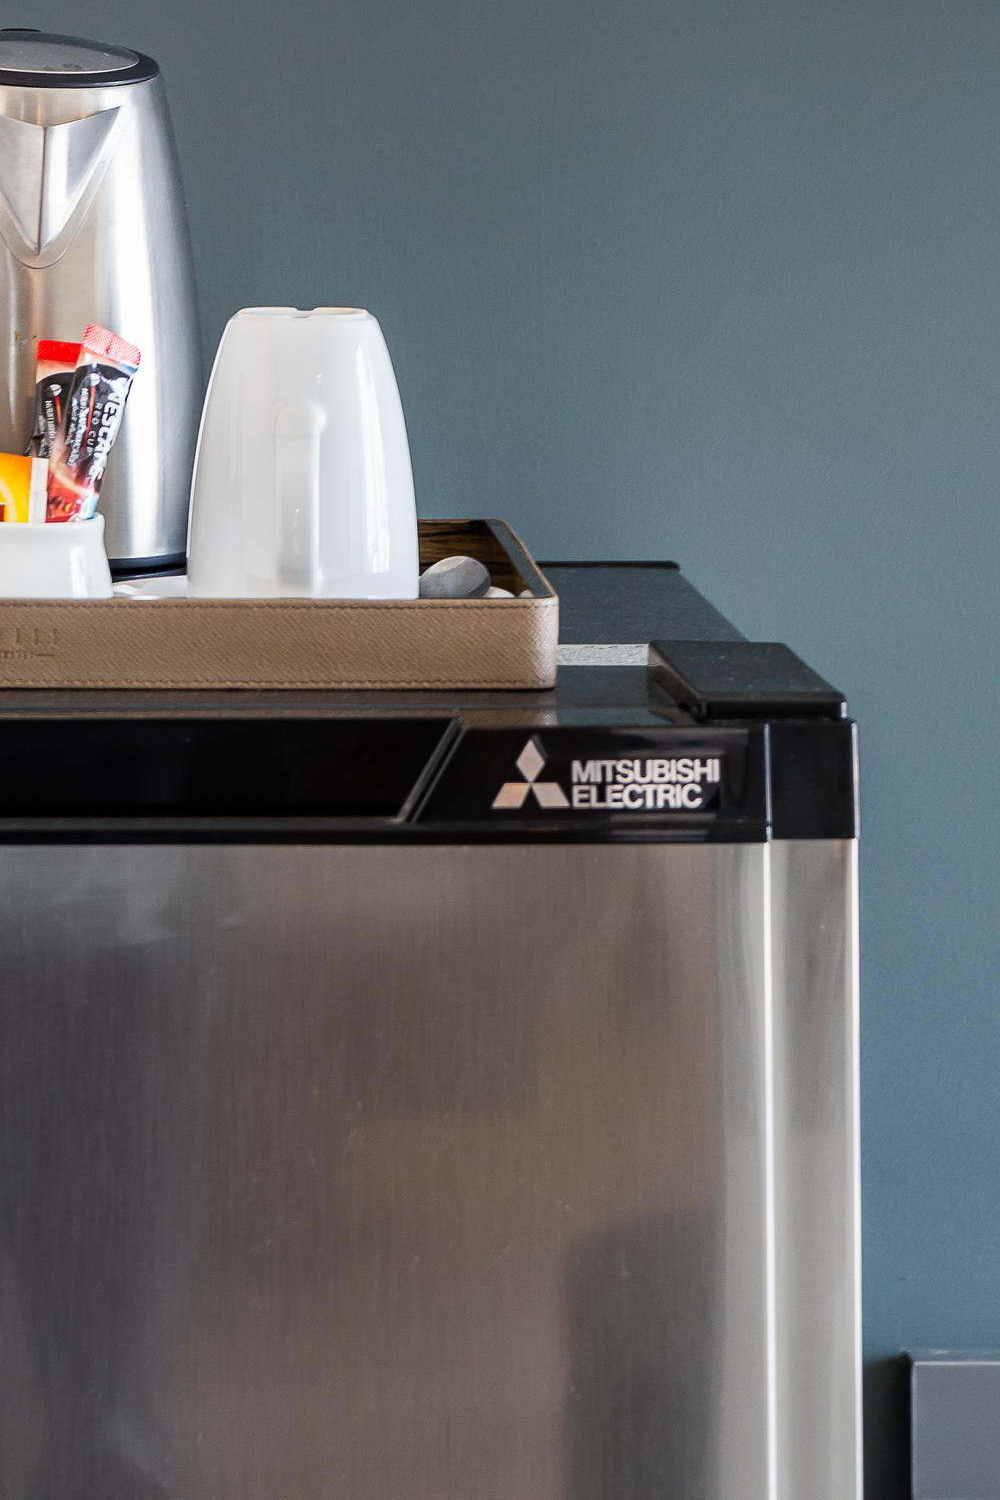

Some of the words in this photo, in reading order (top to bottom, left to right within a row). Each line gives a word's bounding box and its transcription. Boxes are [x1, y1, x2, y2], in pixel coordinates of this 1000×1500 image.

[90, 402, 103, 424] RED
[86, 431, 98, 455] CUP
[571, 758, 720, 783] MITSUBISHI
[571, 784, 703, 809] ELECTRIC
